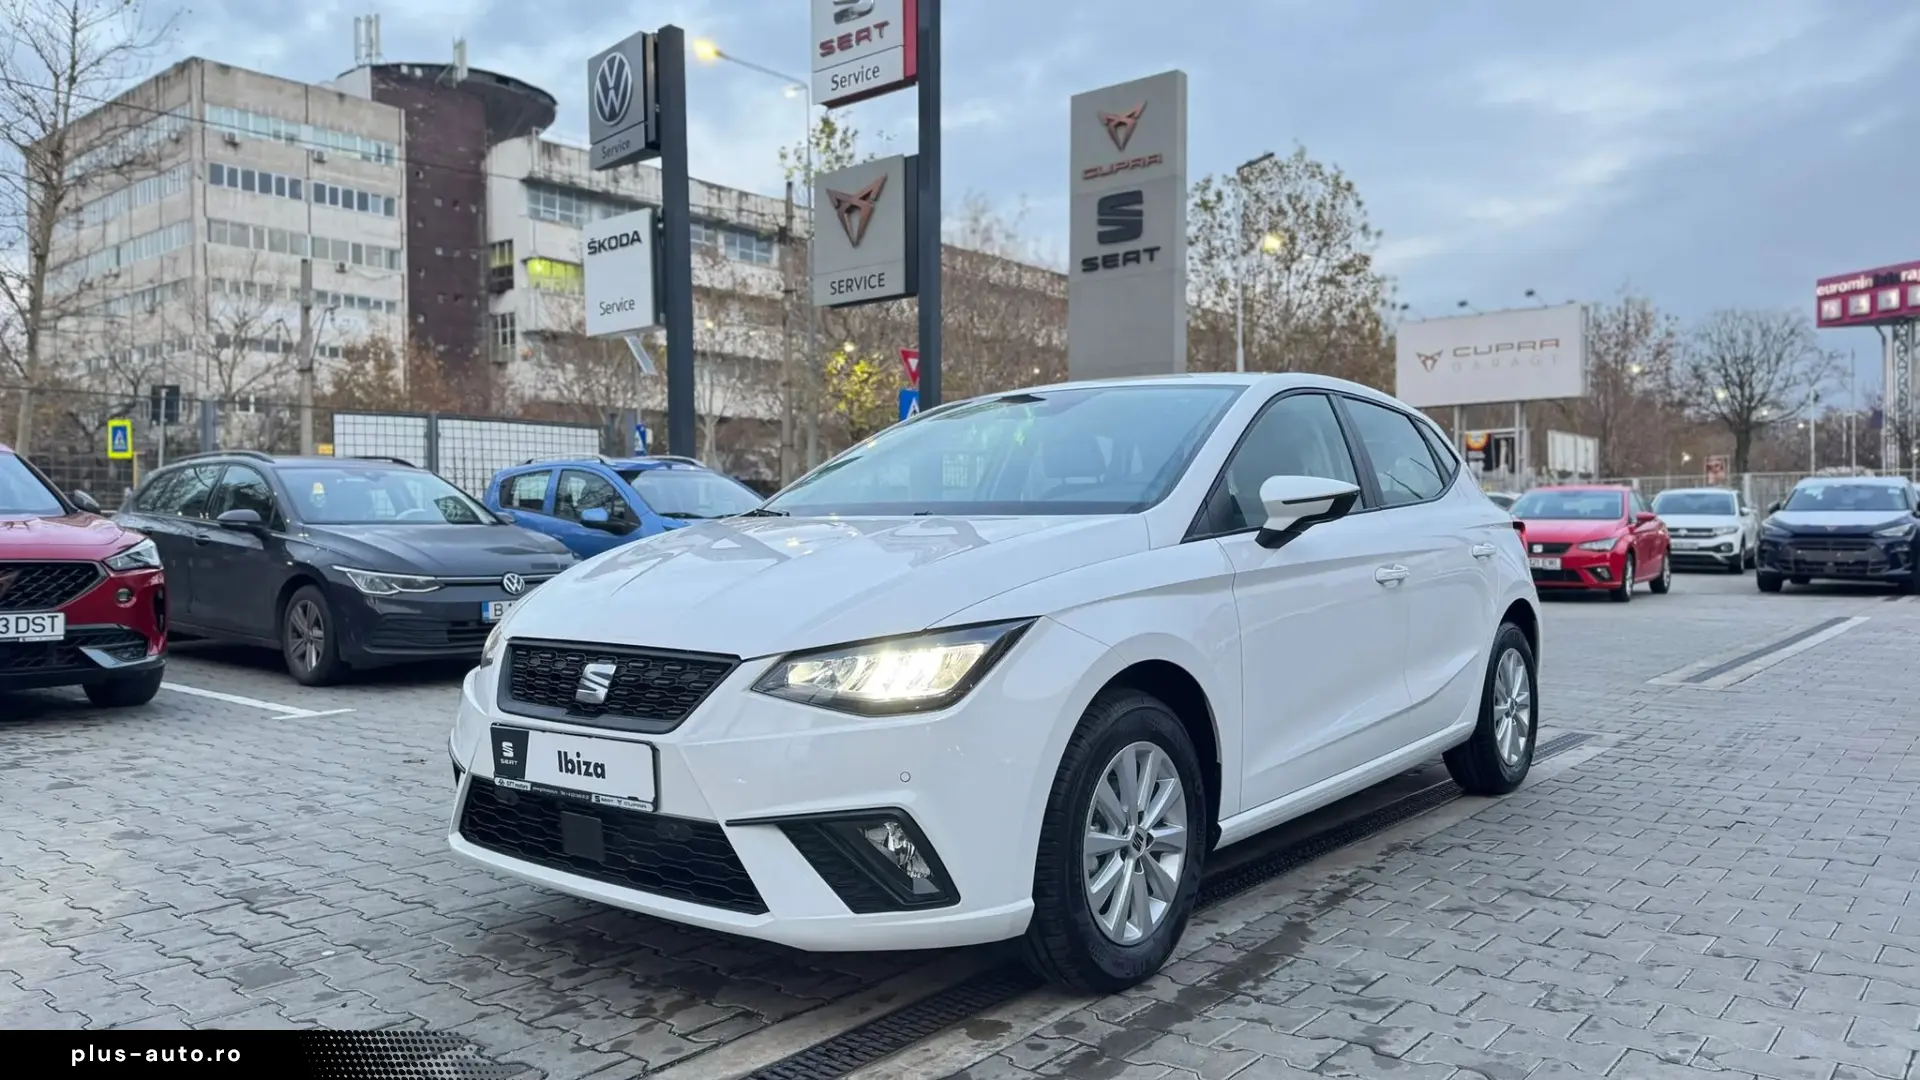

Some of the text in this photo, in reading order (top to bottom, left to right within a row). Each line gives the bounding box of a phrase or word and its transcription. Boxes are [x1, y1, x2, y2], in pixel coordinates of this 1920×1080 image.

[819, 20, 890, 57] SEAT
[830, 65, 880, 91] Service
[601, 140, 631, 159] Service
[1082, 153, 1163, 180] CUPRA
[587, 230, 643, 256] ŠKODA
[1081, 246, 1161, 273] SEAT
[829, 272, 886, 296] SERVICE
[599, 296, 636, 316] Service
[1452, 338, 1560, 358] CUPRA
[493, 603, 504, 617] B
[0, 615, 59, 634] 3 DST
[500, 758, 519, 766] SEAT
[557, 749, 606, 780] Ibiza
